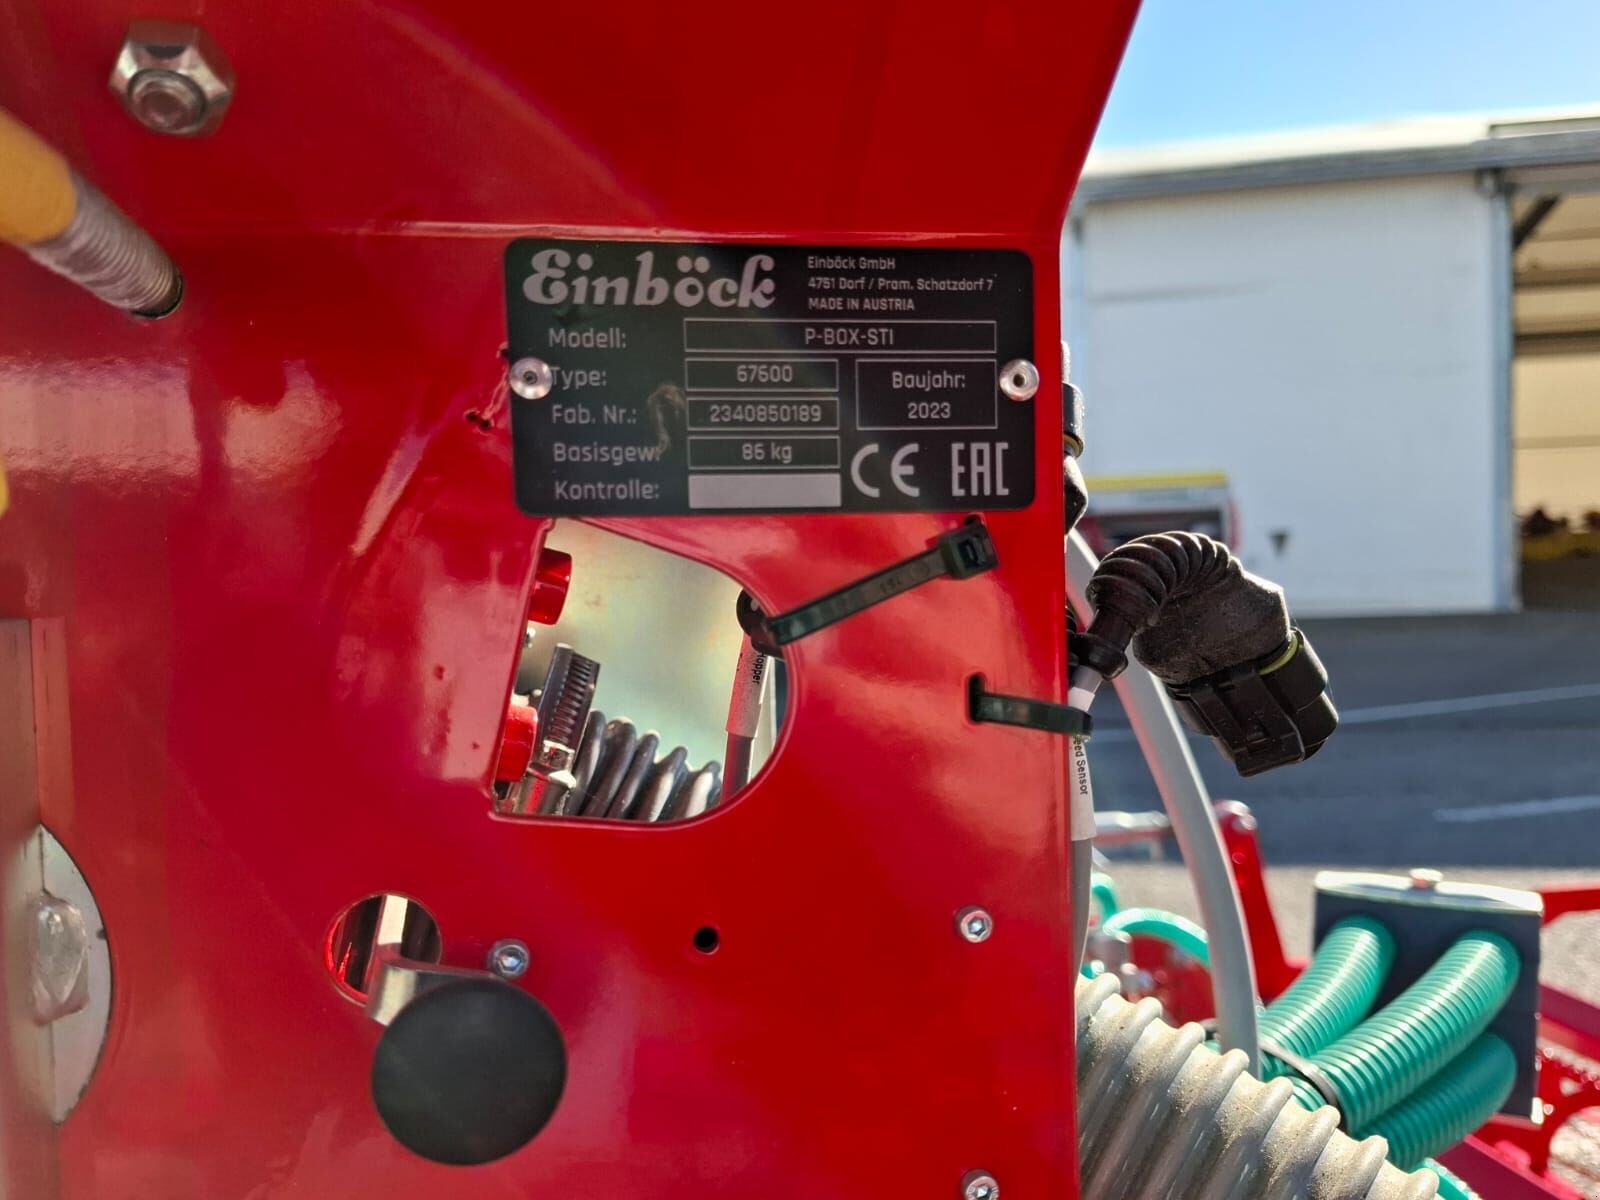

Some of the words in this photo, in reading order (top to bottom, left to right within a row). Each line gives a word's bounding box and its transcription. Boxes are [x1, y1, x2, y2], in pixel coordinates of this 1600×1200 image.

[807, 256, 856, 269] Einböck
[859, 257, 896, 270] GmbH
[523, 248, 776, 308] Einböck
[839, 277, 865, 290] Dorf
[917, 277, 984, 292] Schatzdorf
[808, 297, 843, 311] MADE
[847, 298, 859, 310] IN
[863, 298, 915, 311] AUSTRIA
[550, 327, 627, 348] Modell:
[804, 328, 894, 345] P-BOX-STI
[551, 366, 608, 389] Type:
[737, 364, 793, 383] 67600
[891, 371, 966, 391] Baujahr:
[552, 405, 596, 424] Fab.
[603, 405, 637, 424] Nr.:
[709, 404, 822, 423] 2340850189
[907, 402, 951, 419] 2023
[742, 443, 764, 461] 86
[771, 443, 793, 464] kg
[851, 443, 920, 497] CE
[554, 480, 660, 499] Kontrolle:
[1076, 759, 1088, 795] Sensor
